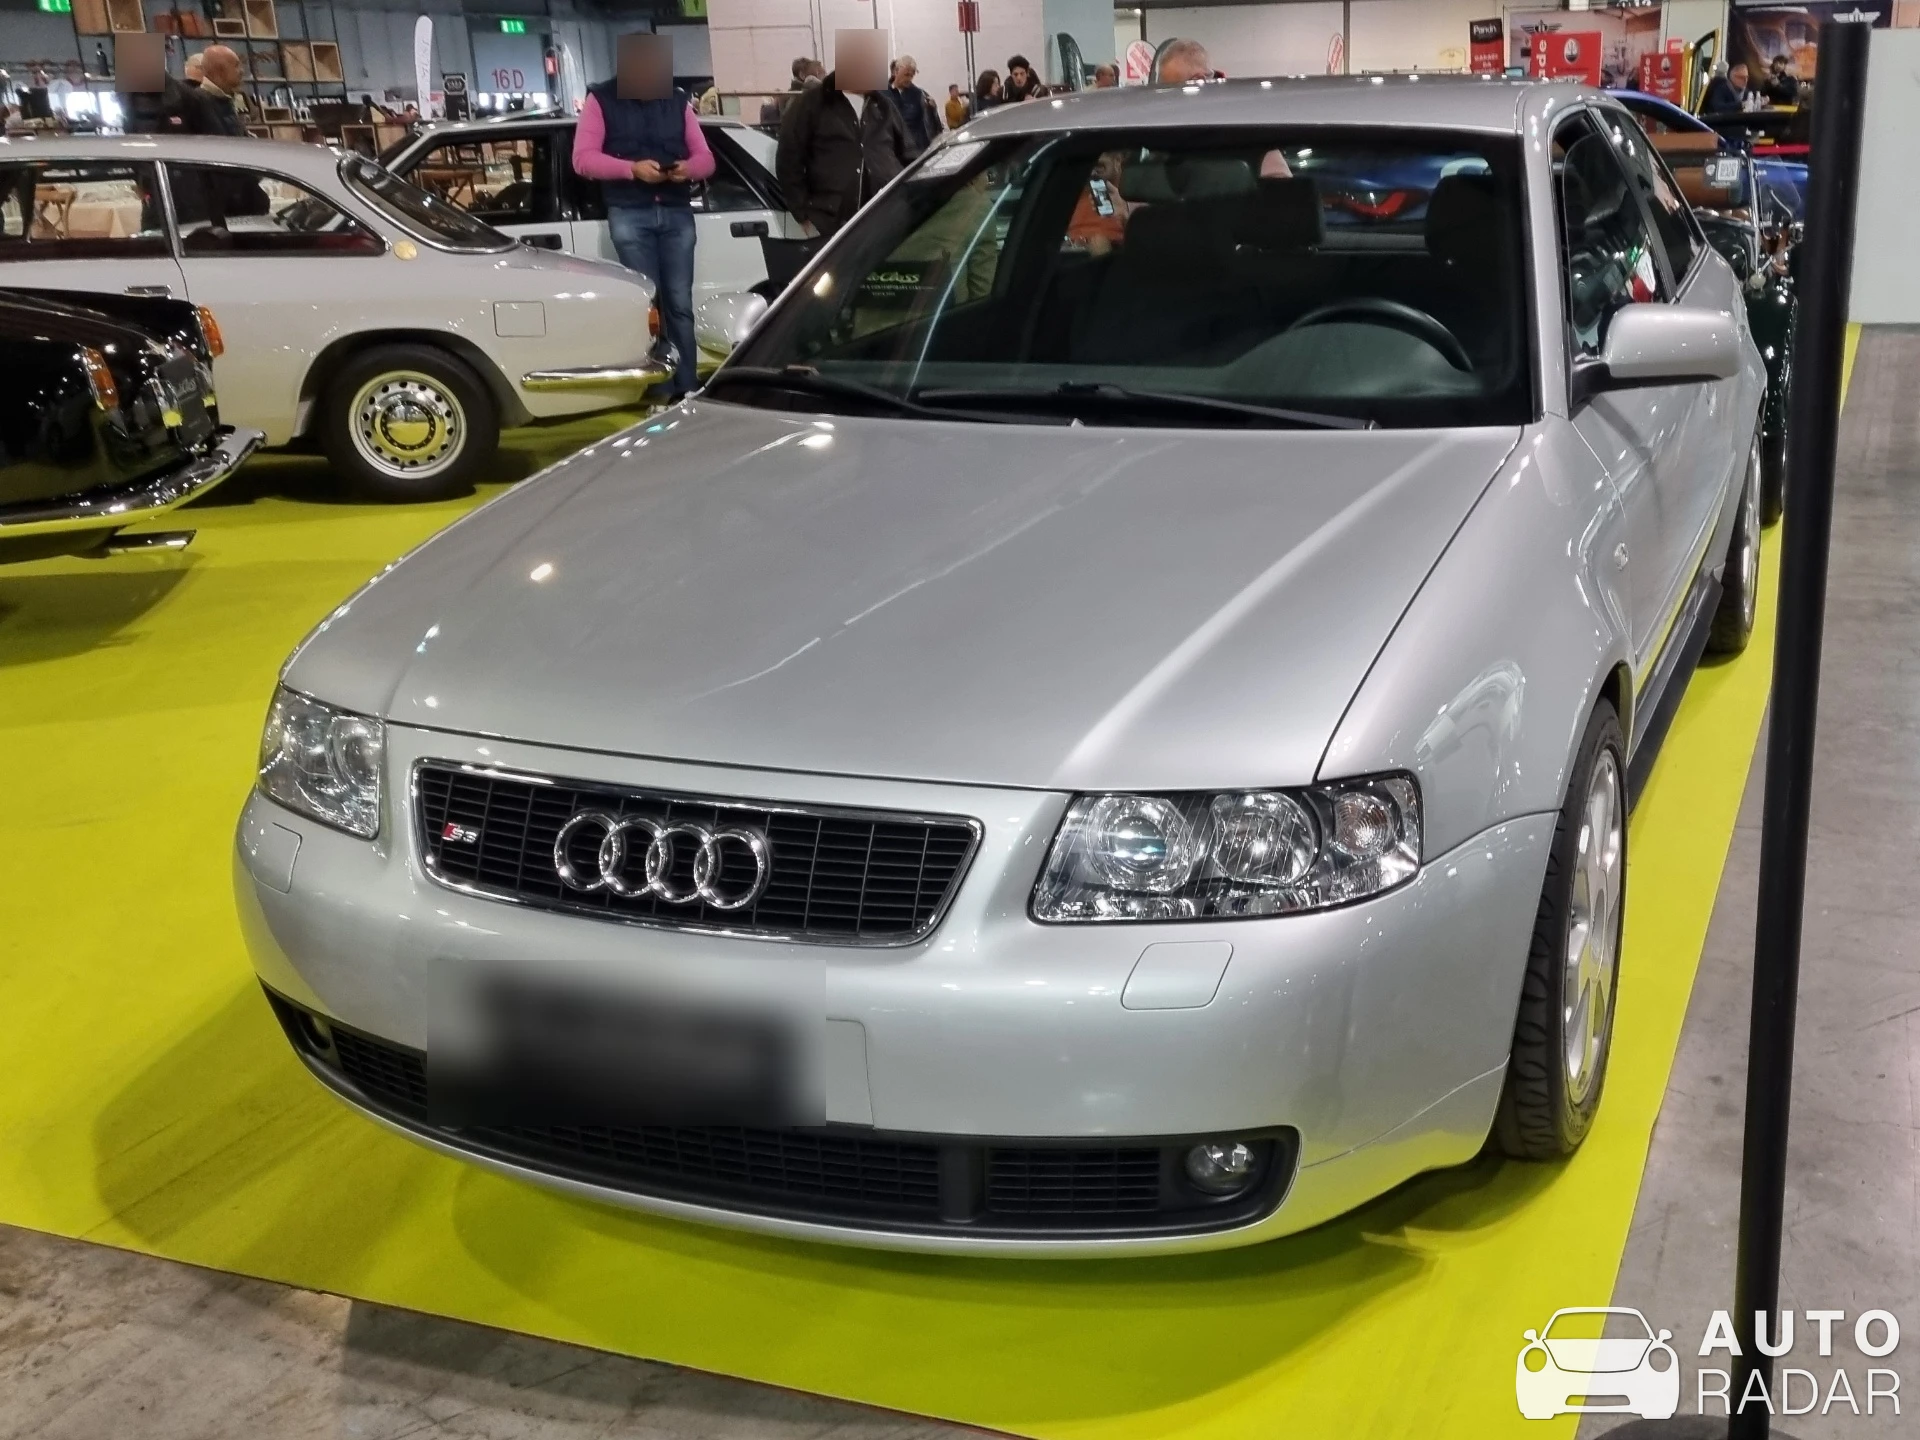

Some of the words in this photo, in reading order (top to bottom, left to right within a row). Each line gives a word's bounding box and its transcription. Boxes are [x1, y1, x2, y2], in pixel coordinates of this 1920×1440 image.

[492, 68, 510, 90] 16
[513, 69, 524, 90] D
[448, 824, 478, 843] S3
